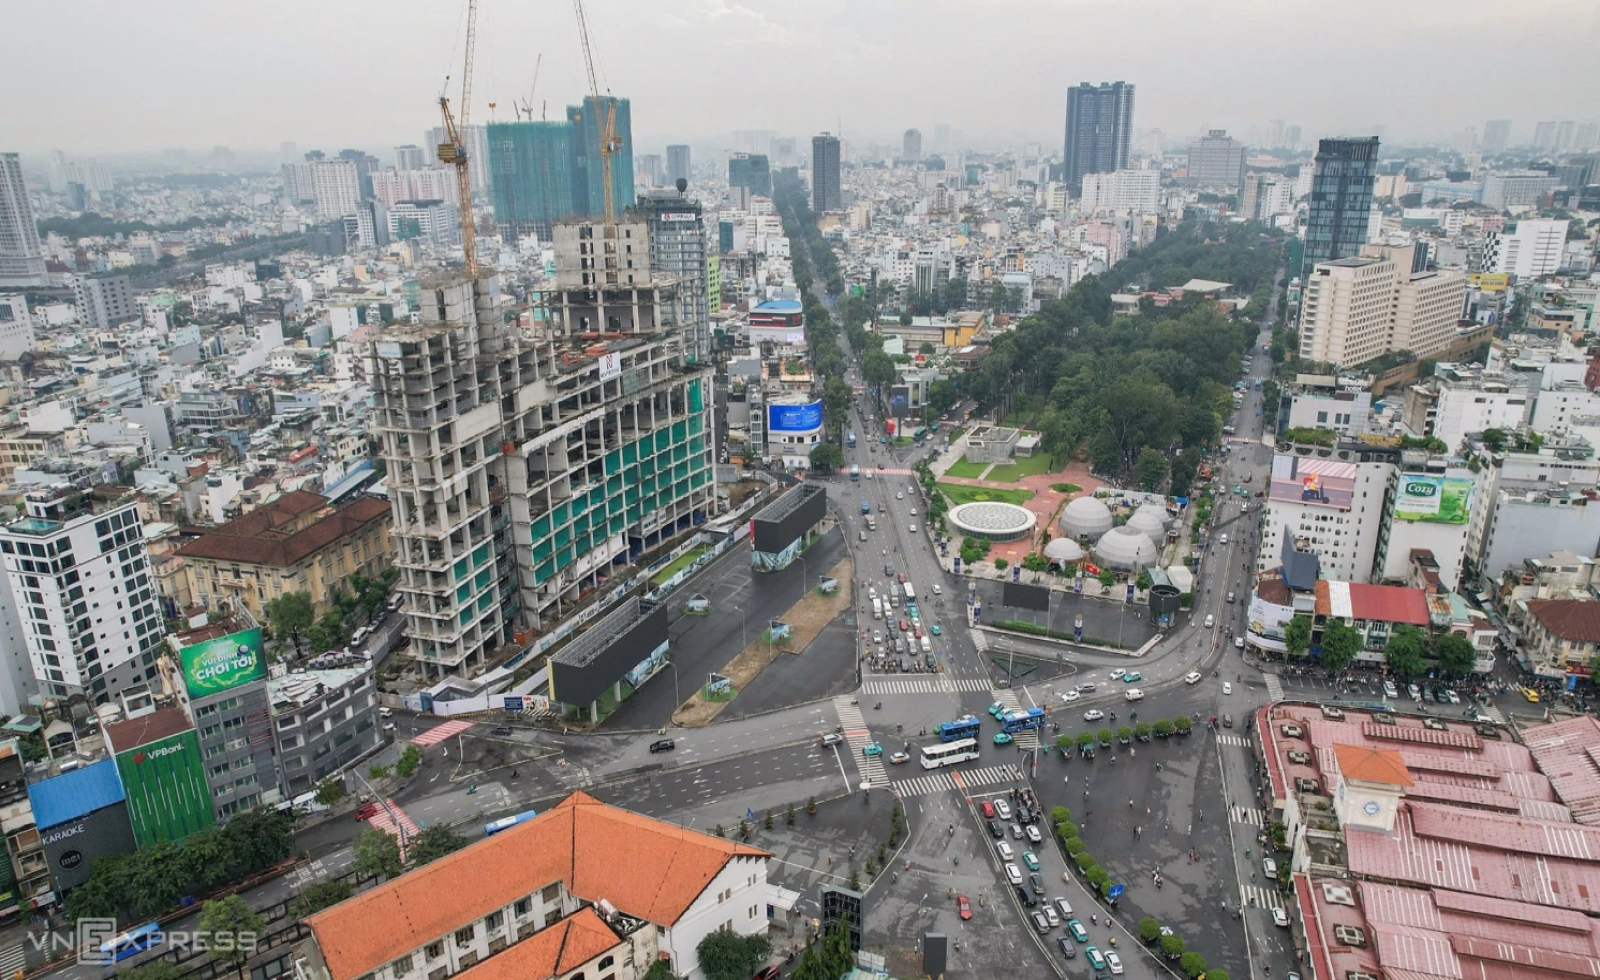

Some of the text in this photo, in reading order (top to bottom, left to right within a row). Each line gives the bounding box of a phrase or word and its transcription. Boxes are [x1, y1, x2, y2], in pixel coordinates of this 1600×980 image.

[1408, 483, 1434, 495] Cozy
[196, 662, 230, 680] CHƠI
[147, 742, 185, 760] VPBank
[42, 823, 86, 846] KARAOKE
[61, 853, 81, 867] mei
